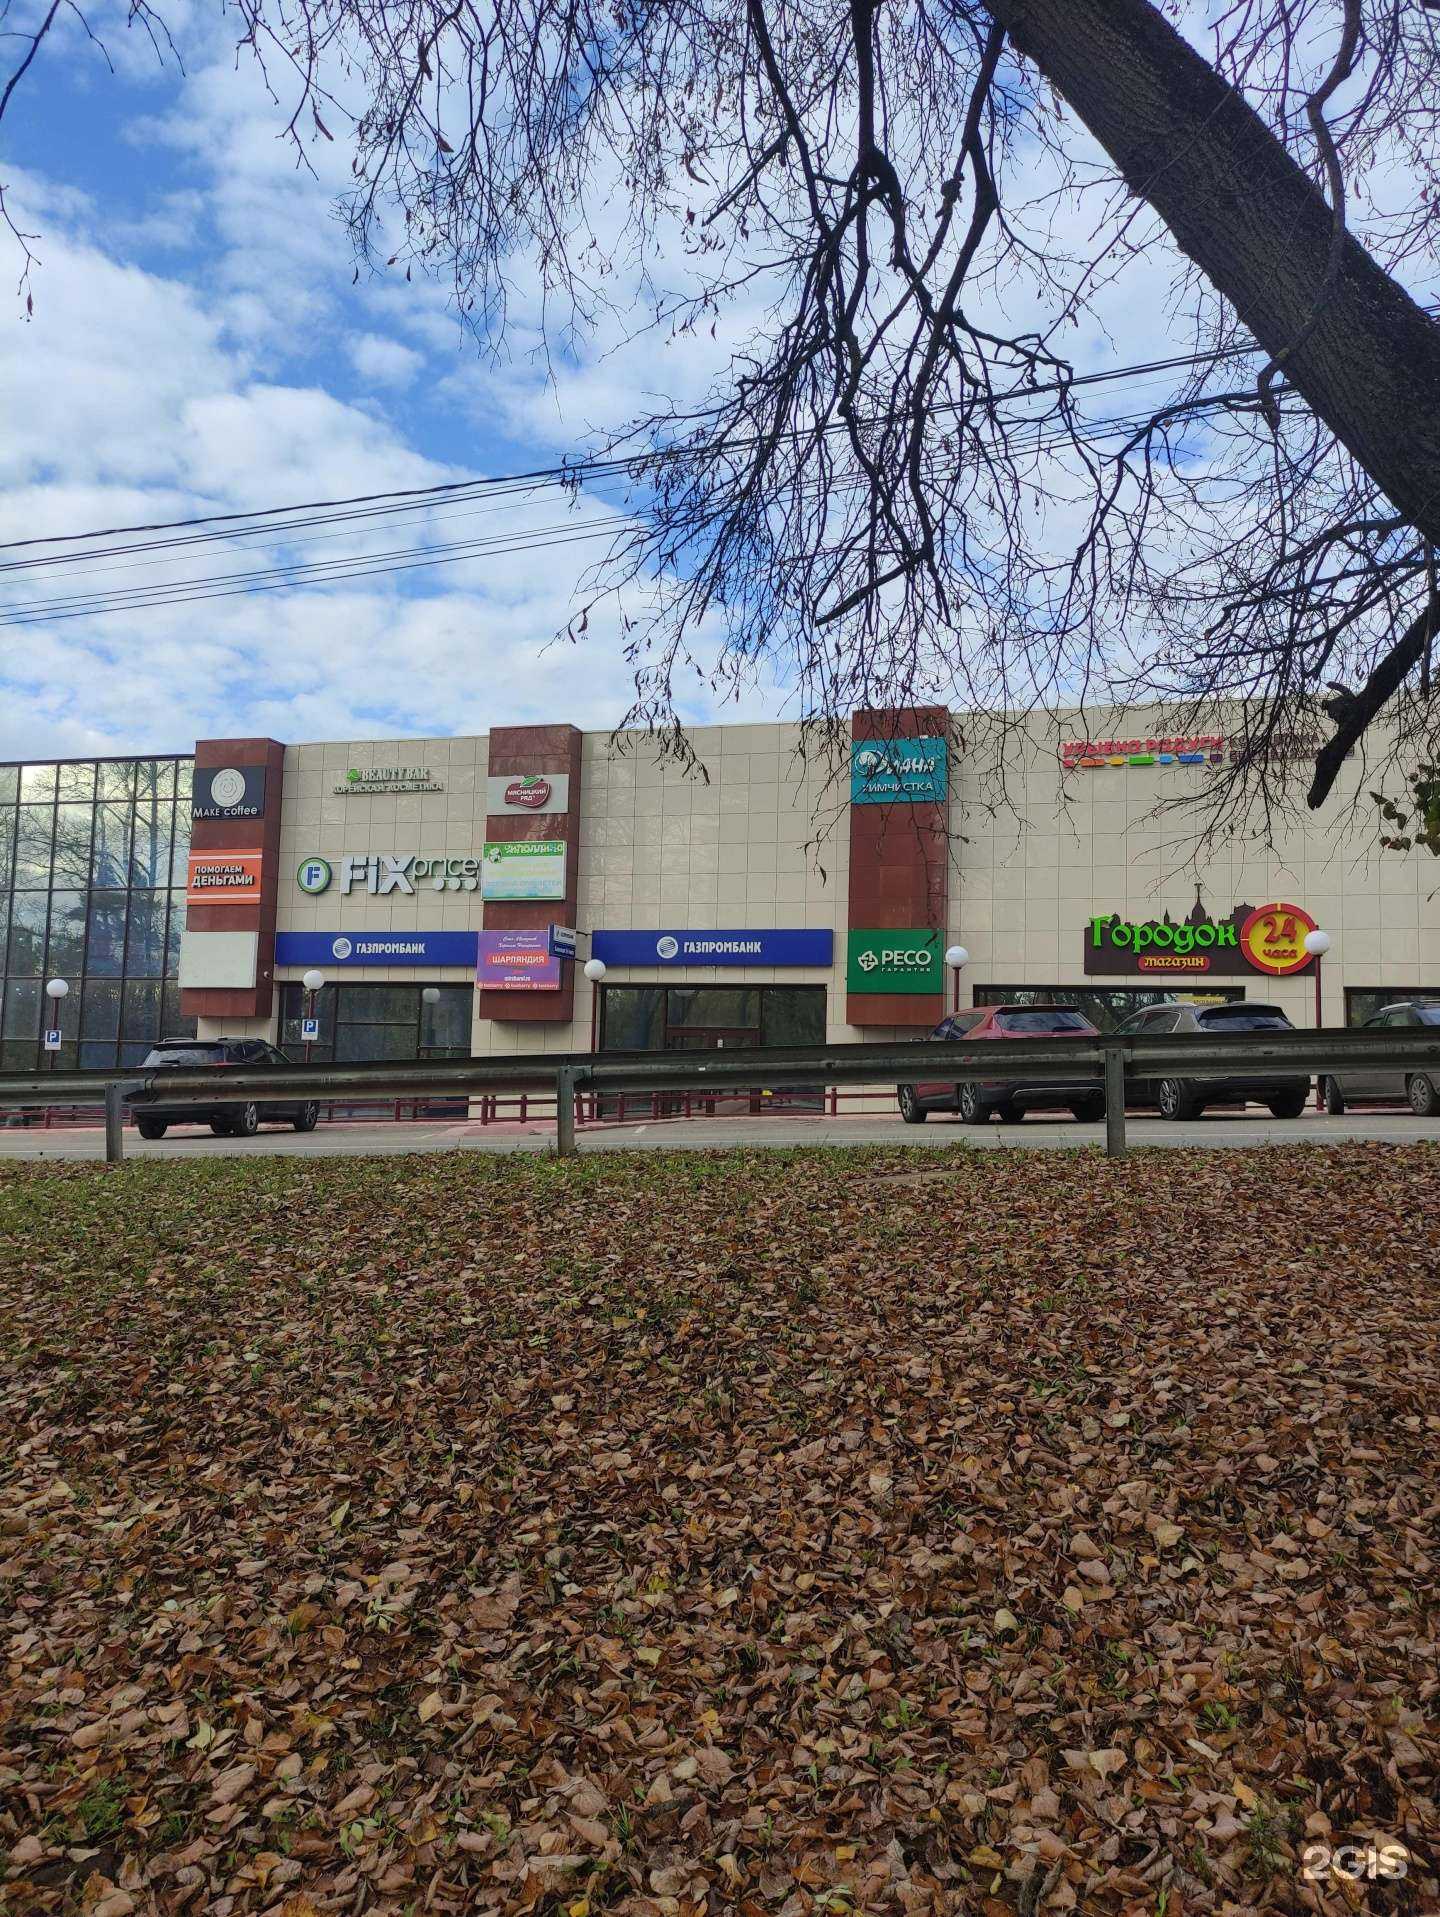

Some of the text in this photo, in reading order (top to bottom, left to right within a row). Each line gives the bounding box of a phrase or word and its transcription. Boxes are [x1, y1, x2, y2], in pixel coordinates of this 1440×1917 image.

[194, 865, 243, 875] ПОМОГАЕМ
[412, 857, 479, 881] price
[191, 875, 254, 888] ДЕНЬГАМИ
[1089, 914, 1239, 954] Городок
[1262, 916, 1298, 945] 24
[356, 942, 426, 954] ГАЗПРОМБАНК
[684, 941, 762, 953] ГАЗПРОМБАНК
[493, 955, 545, 964] ШАРЛЯНДИЯ
[881, 950, 932, 965] РЕСО
[1144, 957, 1205, 969] магазин
